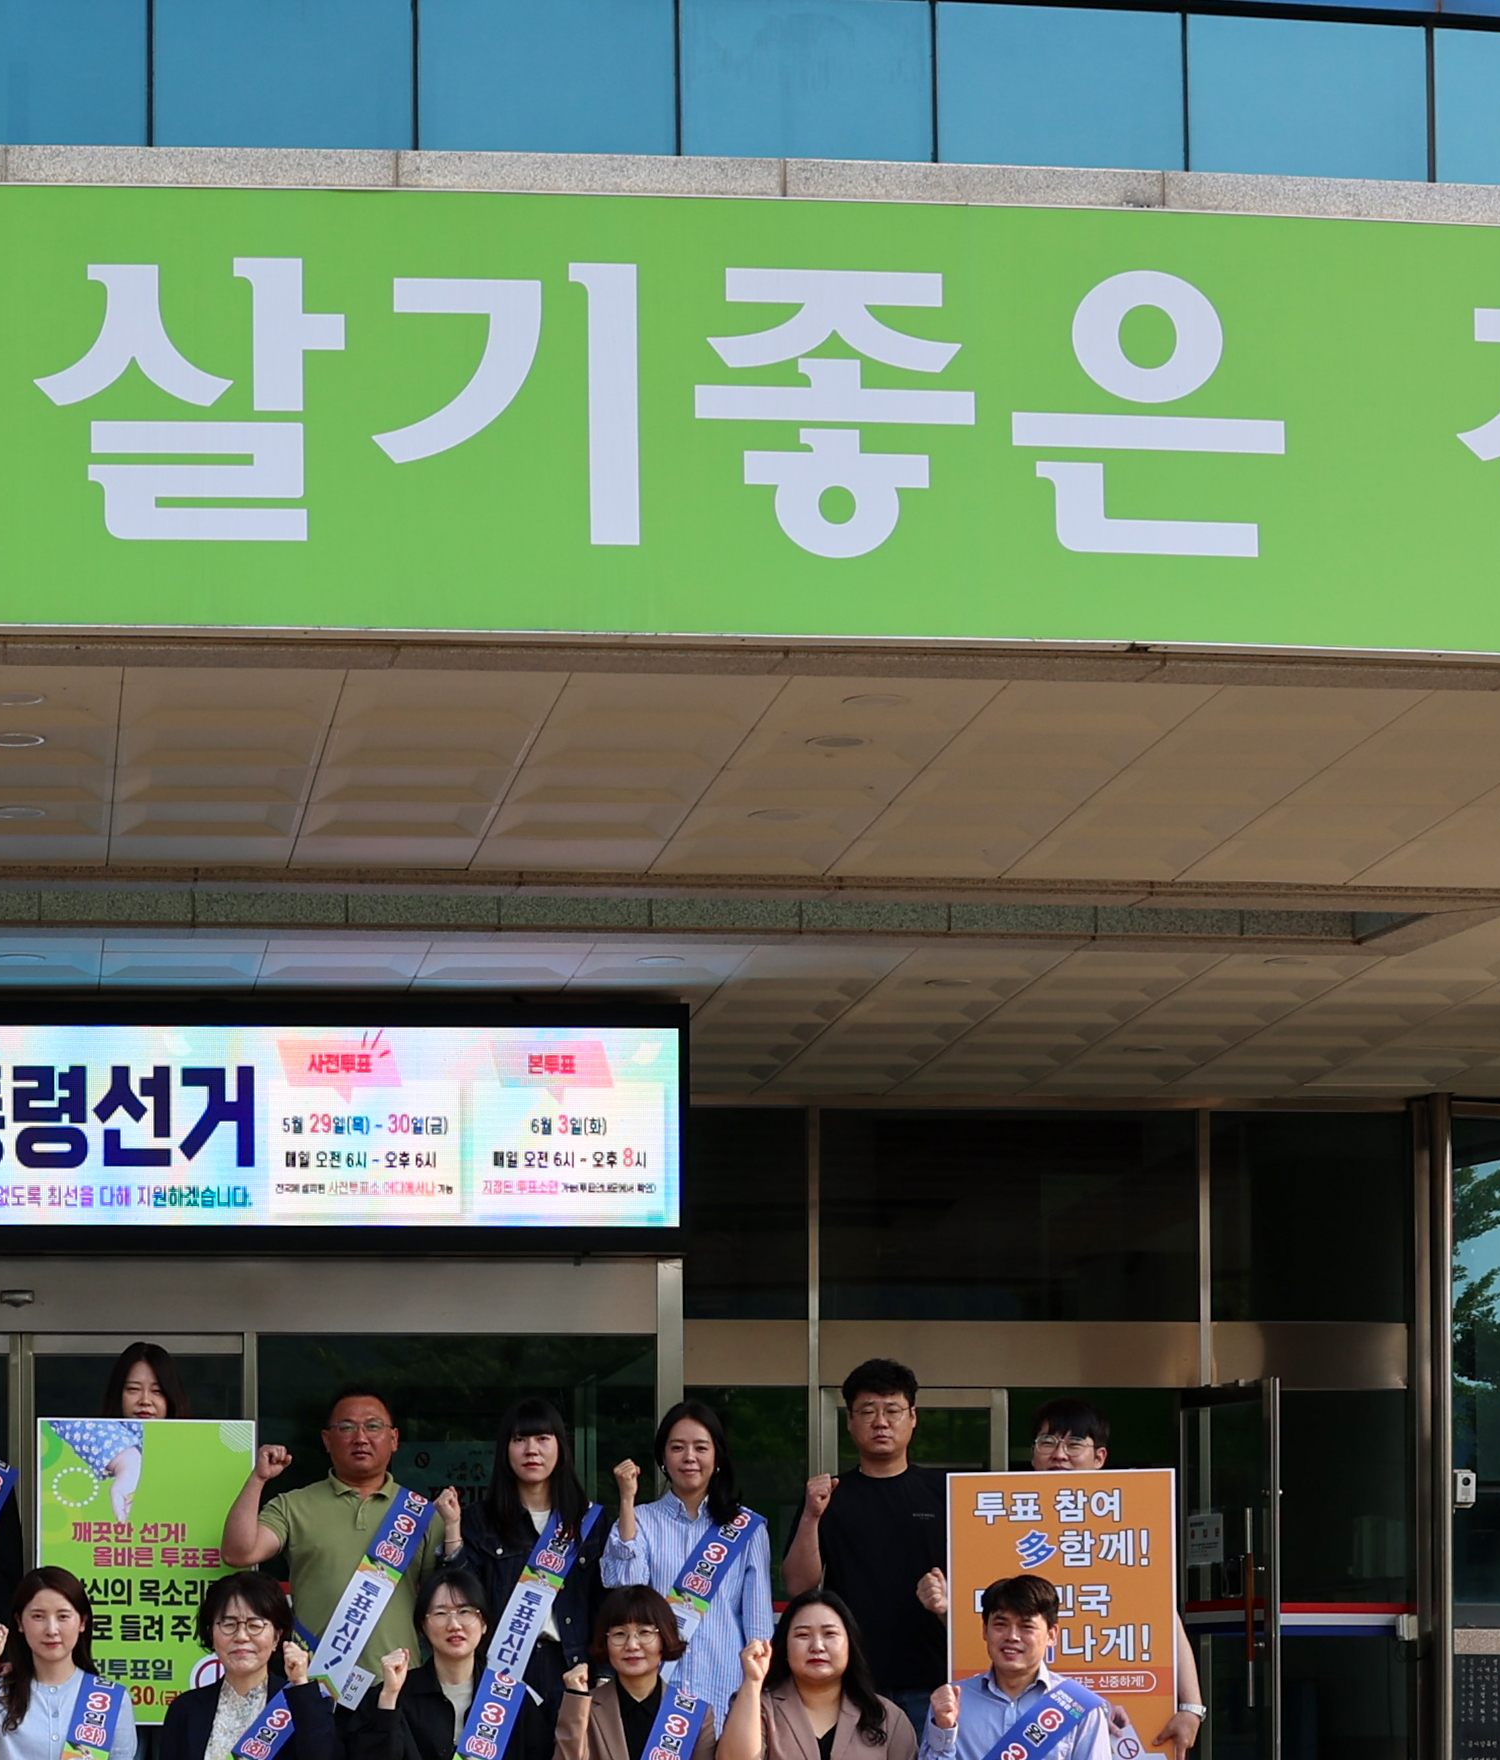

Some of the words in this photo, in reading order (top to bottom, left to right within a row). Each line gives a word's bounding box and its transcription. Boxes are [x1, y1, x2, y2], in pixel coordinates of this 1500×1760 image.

[33, 256, 1286, 560] 살기좋은
[308, 1054, 372, 1073] 사전투표
[528, 1054, 576, 1074] 본투표
[283, 1116, 303, 1134] 5월
[310, 1113, 370, 1135] 29일(목)
[388, 1113, 449, 1135] 30일(금)
[531, 1117, 552, 1135] 6월
[558, 1114, 607, 1135] 3일(화)
[285, 1151, 310, 1168] 매일
[316, 1151, 341, 1168] 오전
[346, 1151, 367, 1168] 6시
[384, 1151, 411, 1168] 오후
[415, 1151, 437, 1168] 6시
[493, 1151, 518, 1168] 매일
[524, 1151, 549, 1168] 오전
[553, 1151, 575, 1168] 6시
[592, 1151, 618, 1168] 오후
[622, 1147, 647, 1168] 8시
[48, 1185, 94, 1207] 최선을
[100, 1185, 132, 1207] 다해
[137, 1185, 253, 1207] 지원하겠습니다.
[973, 1490, 1043, 1525] 투표
[1054, 1487, 1121, 1523] 참여
[71, 1521, 134, 1543] 깨끗한
[139, 1522, 186, 1543] 선거!
[375, 1514, 416, 1567] 3일(화)
[93, 1547, 153, 1567] 올바른
[160, 1548, 221, 1568] 투표로
[682, 1542, 728, 1597] 3일(화)
[81, 1578, 132, 1606] 신의
[120, 1613, 164, 1642] 들려
[171, 1615, 200, 1642] 주
[323, 1579, 381, 1670] 투표합시다!
[1046, 1624, 1152, 1664] 나게!
[1099, 1675, 1145, 1688] 신중하게!
[74, 1692, 112, 1747] 3일(화)
[465, 1702, 506, 1759] 3일(화)
[1023, 1708, 1065, 1747] 6월
[241, 1708, 292, 1760] 3일(화)
